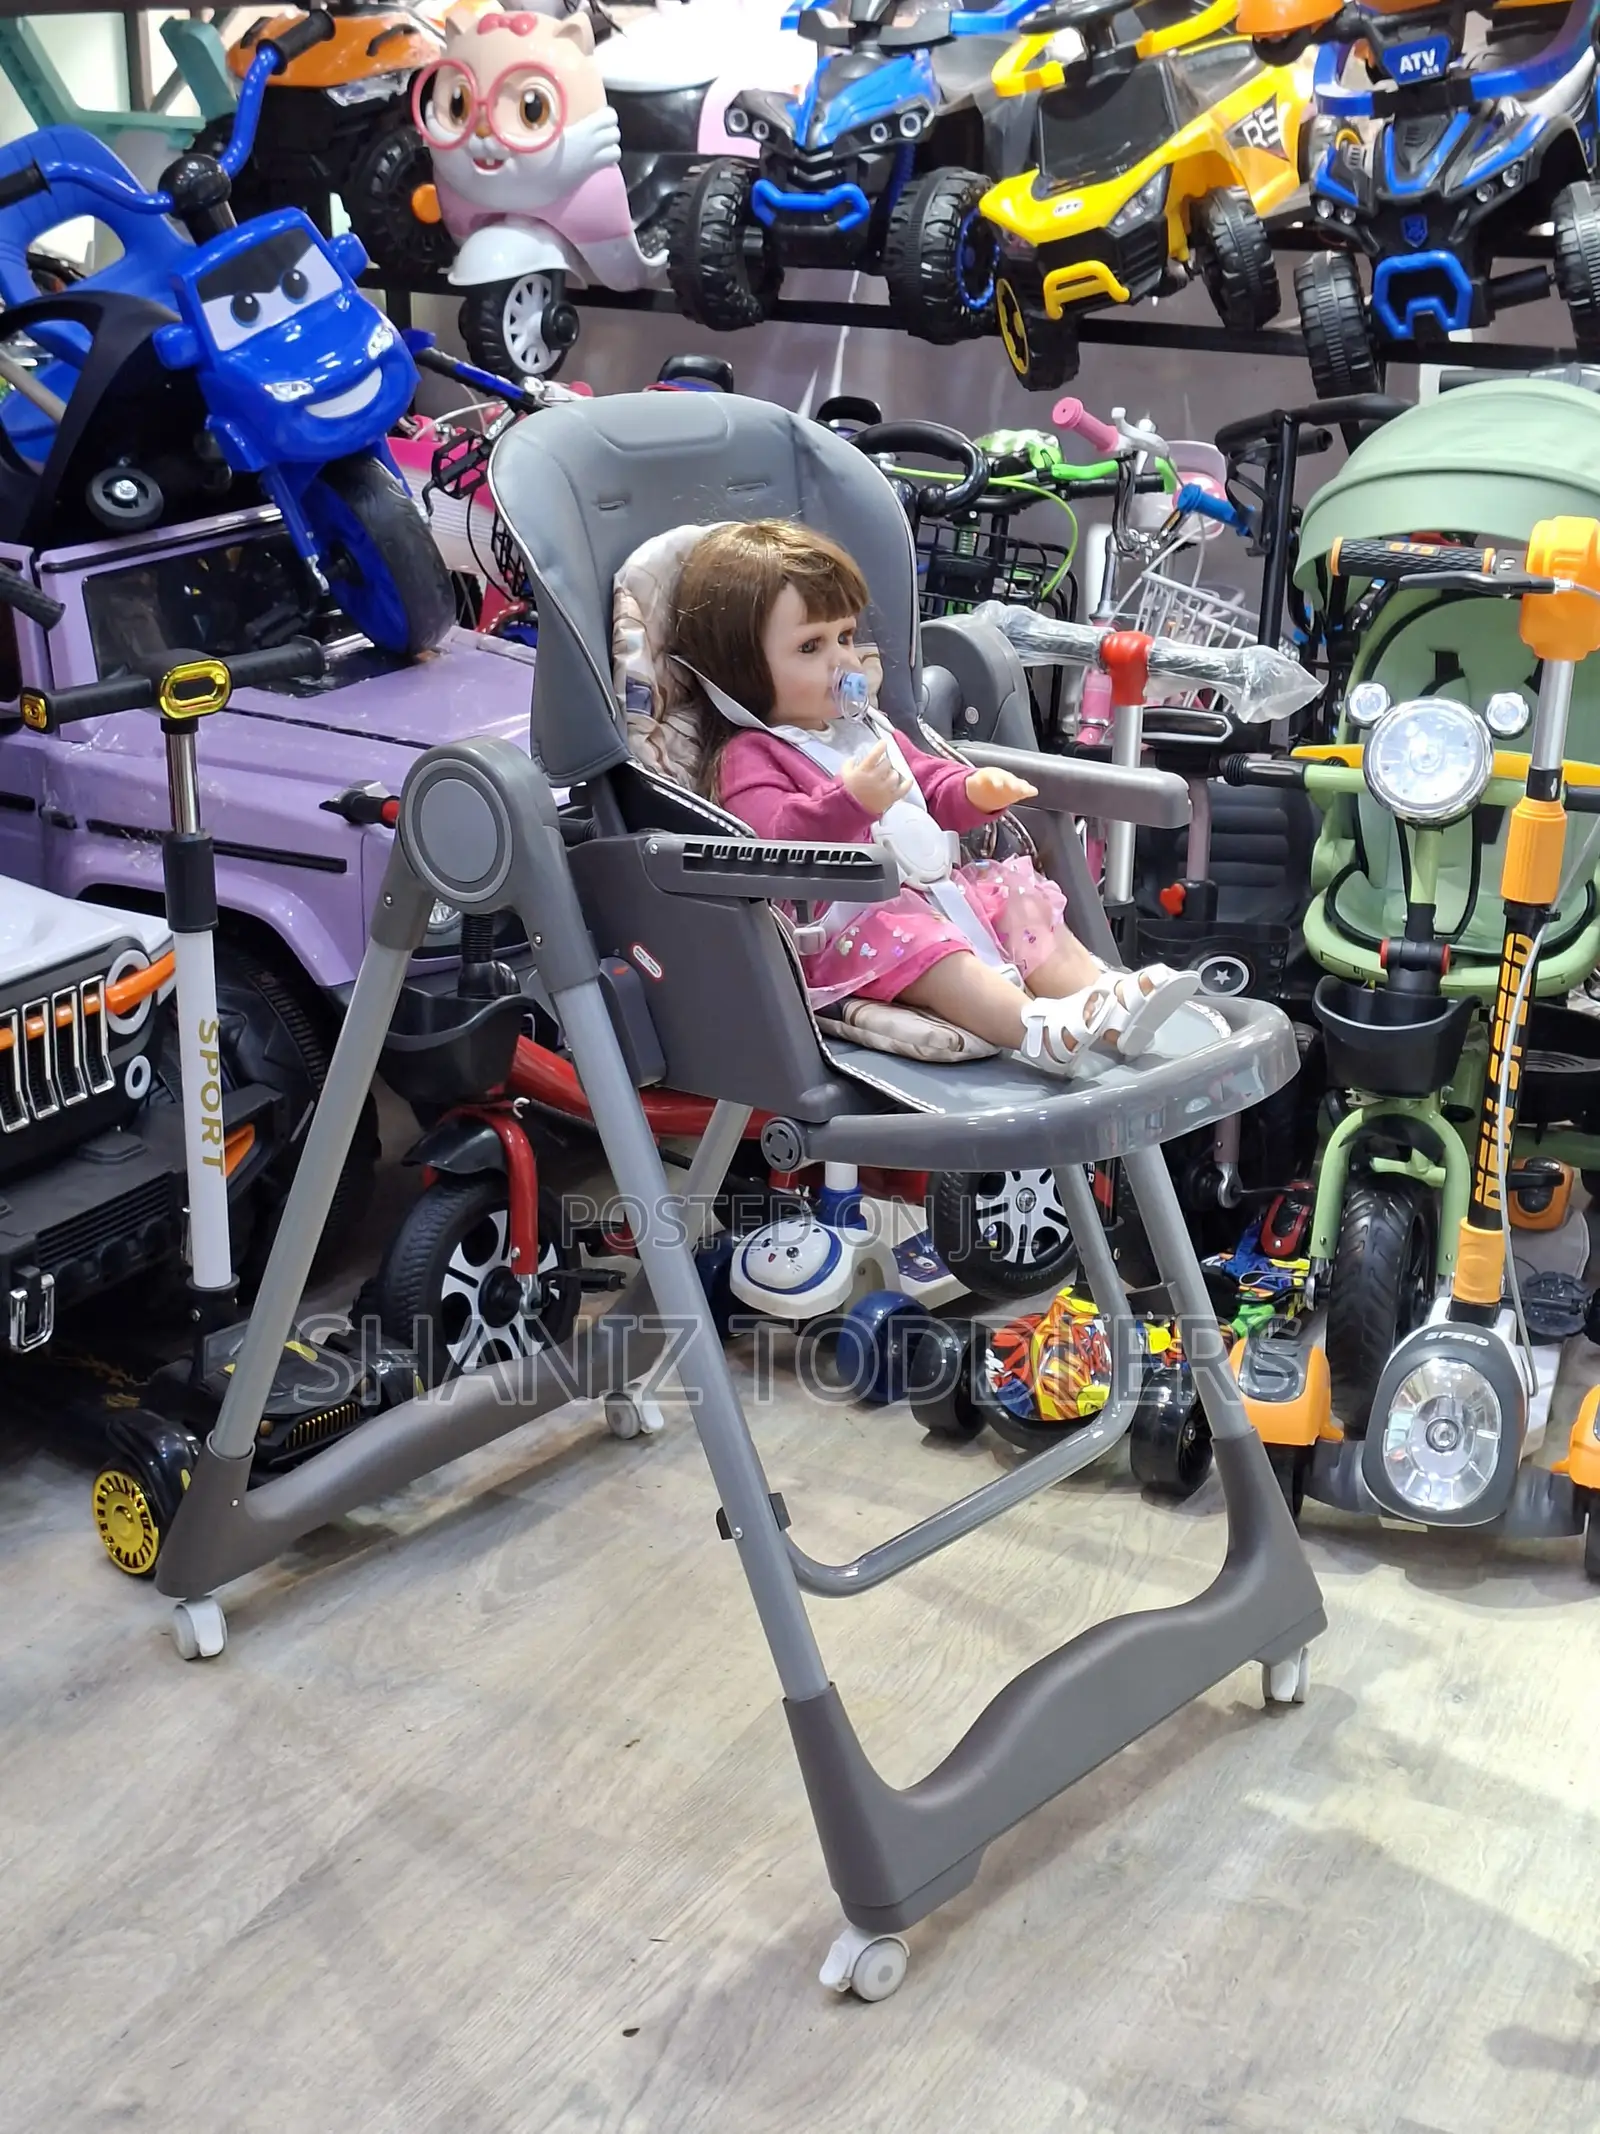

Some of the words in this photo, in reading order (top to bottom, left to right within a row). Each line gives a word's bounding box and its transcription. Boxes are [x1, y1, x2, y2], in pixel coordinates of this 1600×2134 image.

[1400, 48, 1436, 74] ATV
[1242, 105, 1281, 148] RS
[199, 1018, 225, 1176] SPORT
[1424, 1331, 1490, 1347] SPEED
